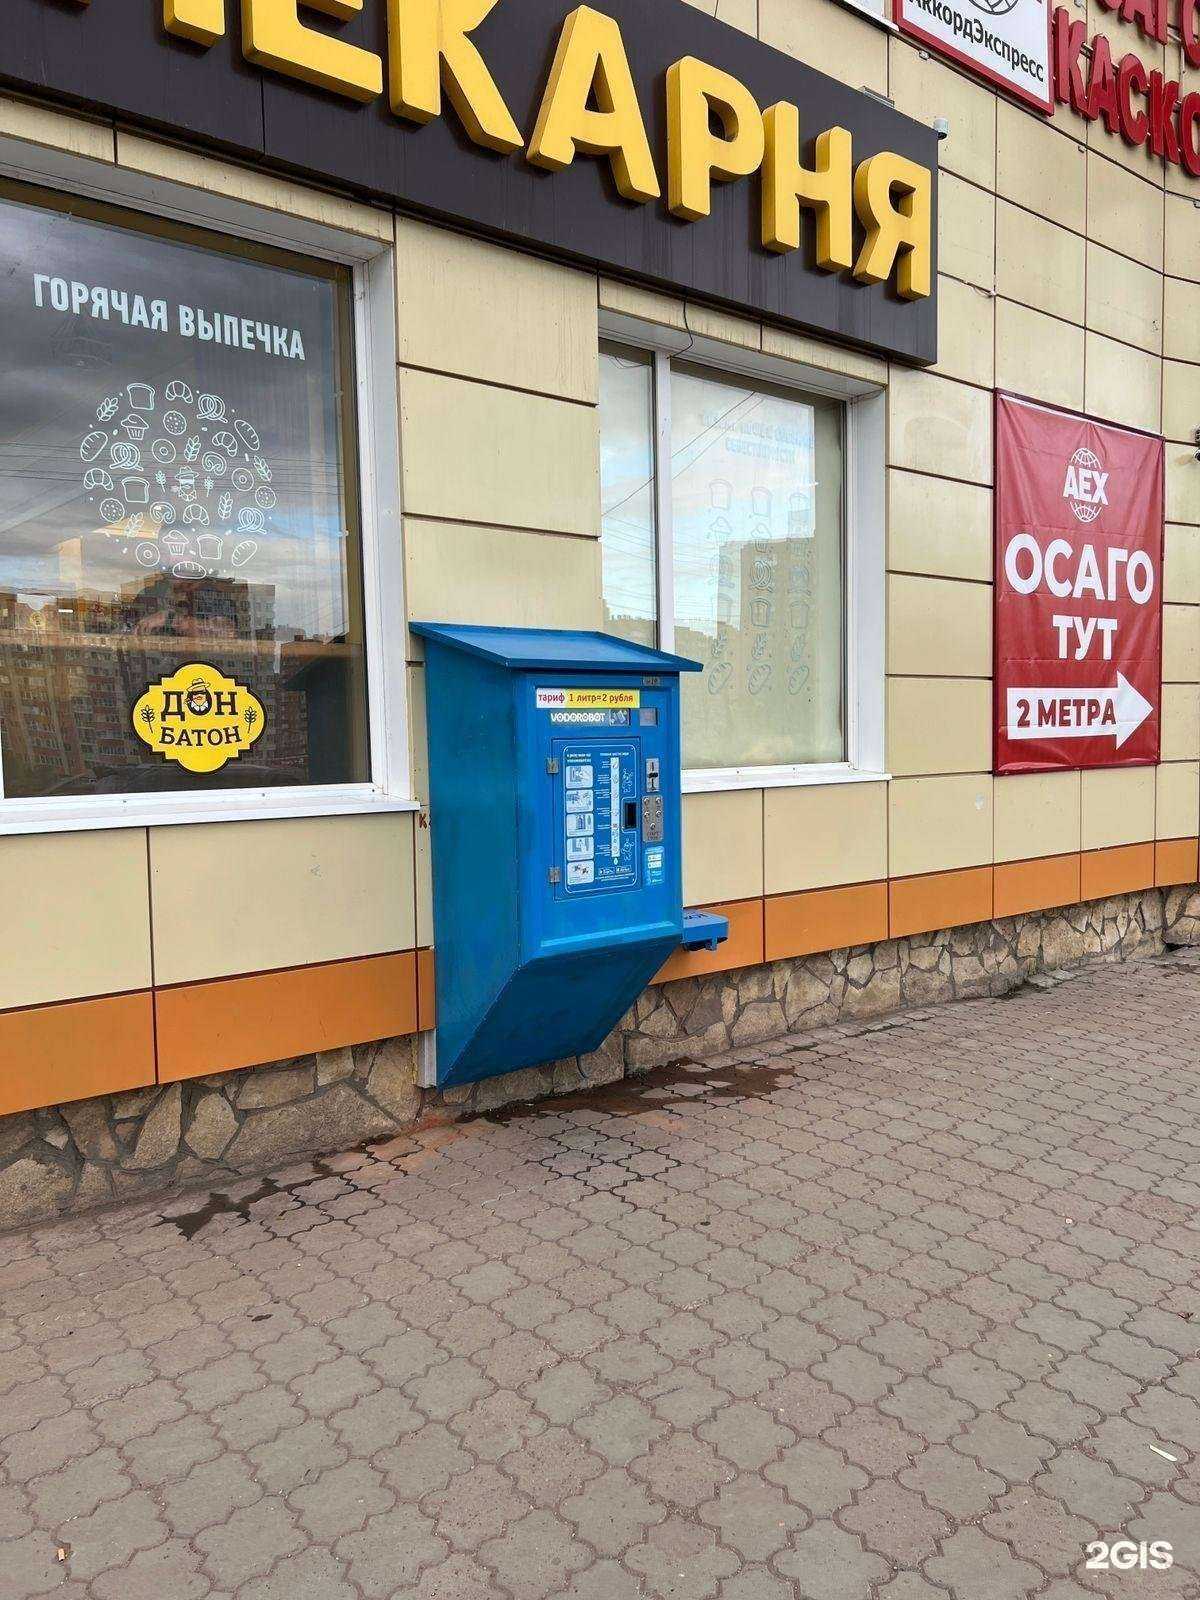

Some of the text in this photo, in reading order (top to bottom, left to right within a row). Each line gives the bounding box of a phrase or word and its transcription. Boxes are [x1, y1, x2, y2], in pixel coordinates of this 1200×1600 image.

[162, 0, 932, 303] КАРНЯ
[33, 273, 306, 361] ГОРЯЧАЯ ВЫПЕЧКА
[1004, 532, 1154, 606] ОСАГО
[1052, 614, 1118, 661] ТУТ
[161, 690, 239, 722] ДОН
[538, 692, 565, 704] тариф
[609, 692, 634, 704] рубля
[1016, 697, 1117, 728] 2 МЕТРА
[550, 712, 606, 723] VODOROBOT
[159, 725, 242, 746] БАТОН
